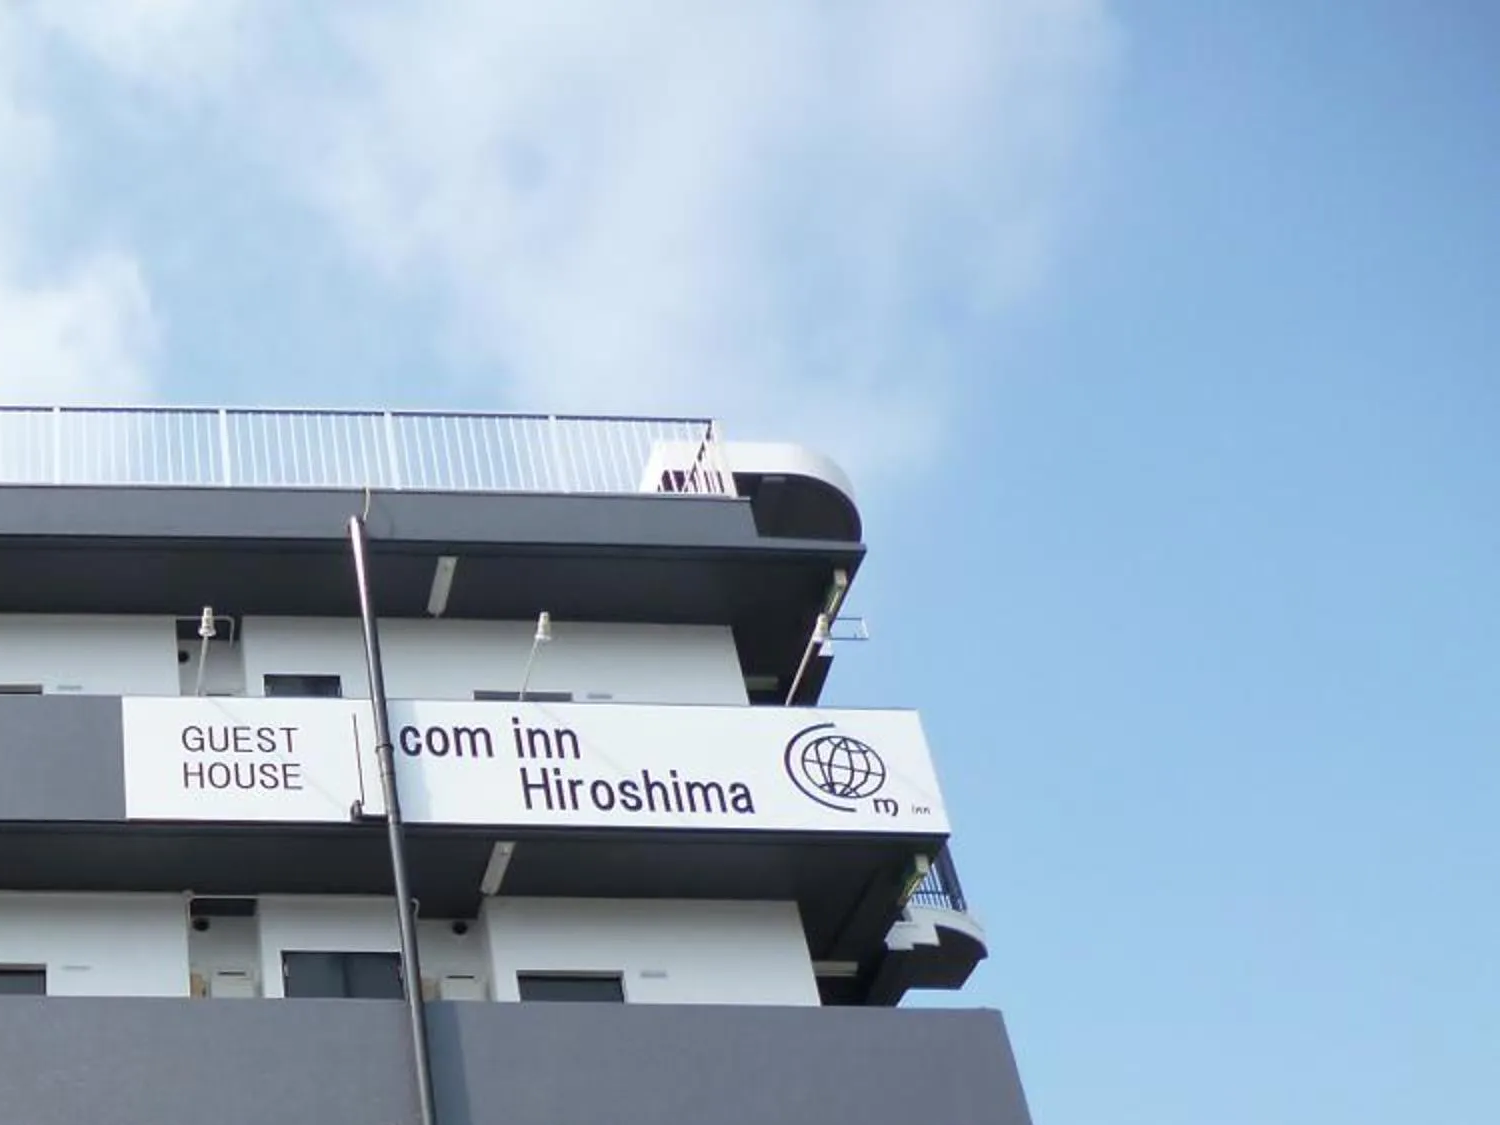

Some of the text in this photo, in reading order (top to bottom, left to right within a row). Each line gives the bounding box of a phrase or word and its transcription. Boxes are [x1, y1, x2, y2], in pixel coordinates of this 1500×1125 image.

[181, 725, 299, 753] GUEST
[399, 717, 581, 759] com inn
[183, 762, 304, 790] HOUSE
[520, 767, 755, 814] Hiroshima
